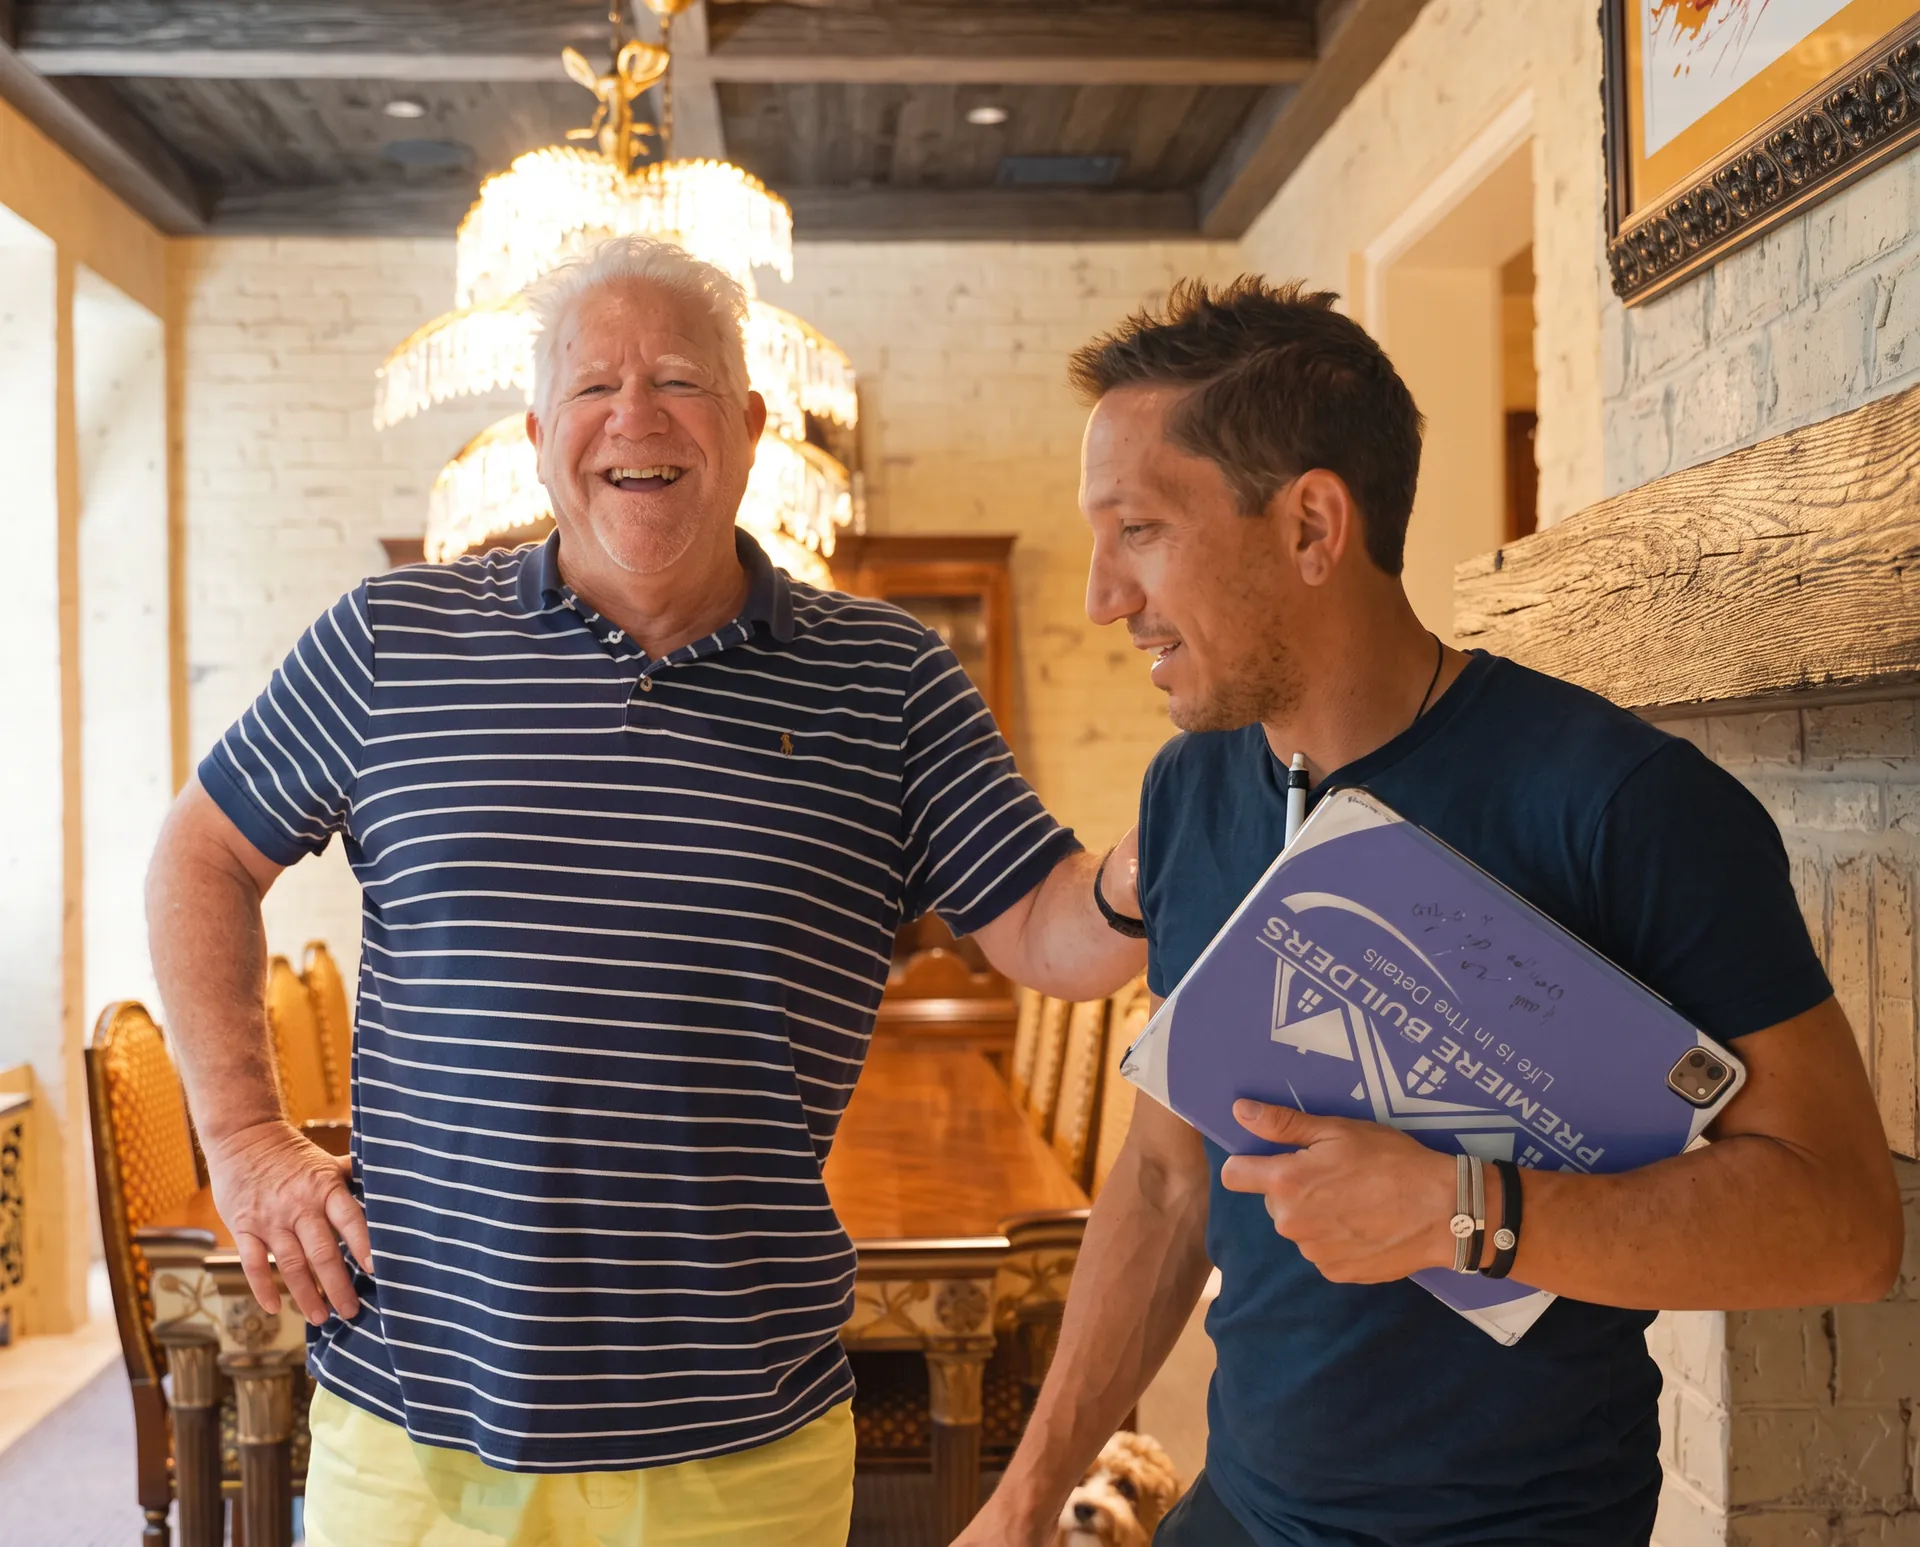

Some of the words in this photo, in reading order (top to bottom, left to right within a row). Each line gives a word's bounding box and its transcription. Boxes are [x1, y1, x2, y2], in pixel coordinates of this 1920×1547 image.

[1262, 917, 1433, 1044] BUILDERS
[1363, 948, 1432, 1006] Details
[1434, 999, 1470, 1035] The
[1474, 1028, 1501, 1052] In
[1496, 1042, 1518, 1064] is
[1517, 1058, 1555, 1092] Life
[1431, 1035, 1605, 1167] PREMIERE
